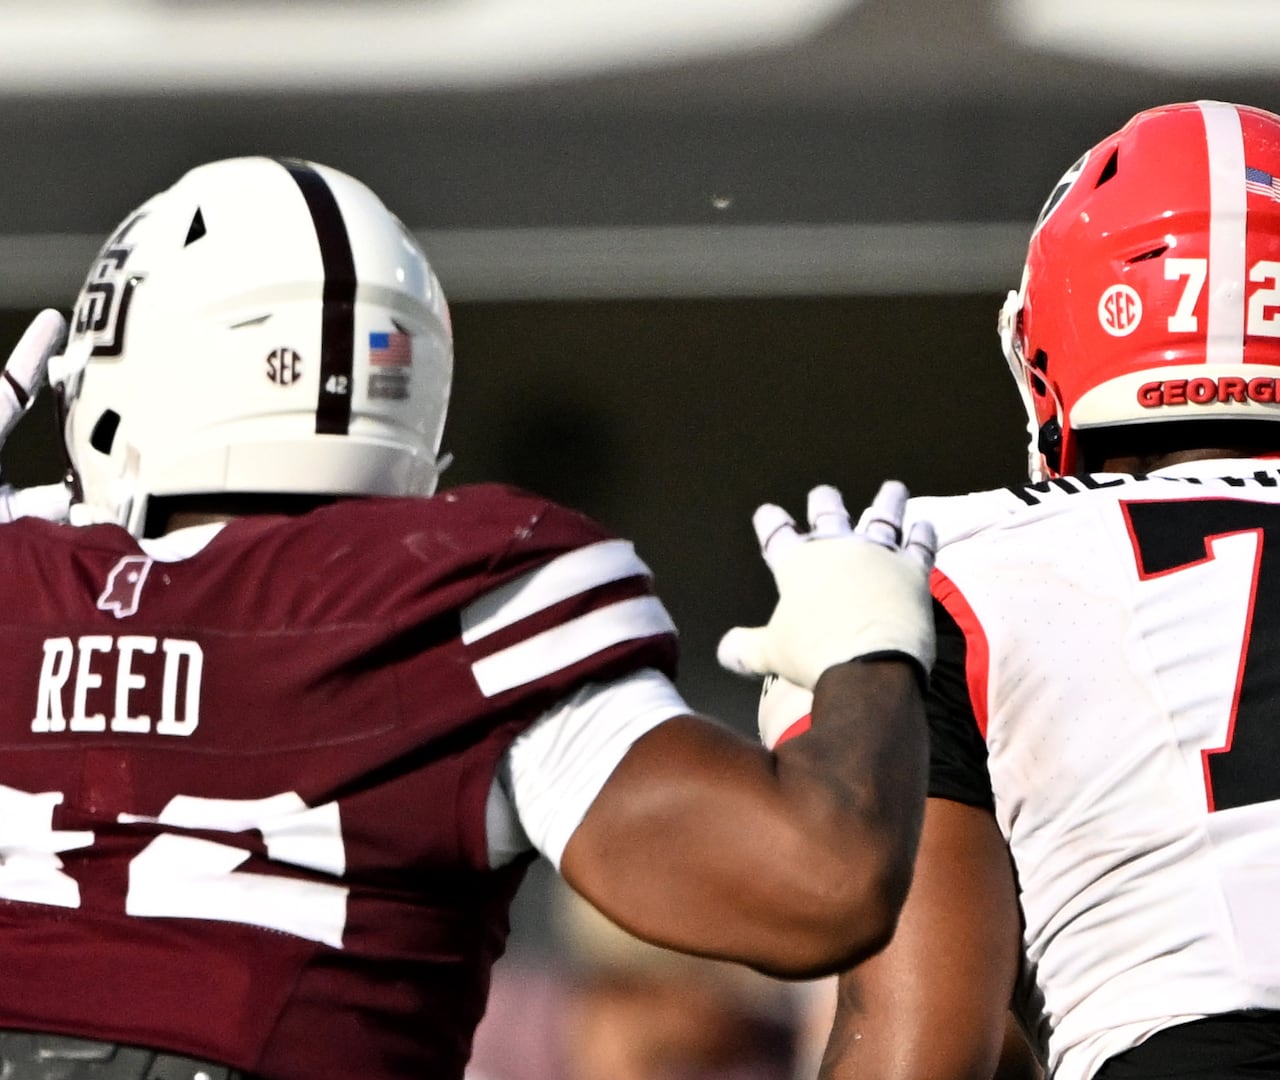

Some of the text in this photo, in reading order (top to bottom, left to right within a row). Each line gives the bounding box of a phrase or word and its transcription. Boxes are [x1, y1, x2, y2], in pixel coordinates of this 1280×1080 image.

[1104, 291, 1137, 330] SEC
[1164, 258, 1280, 338] 72
[266, 348, 301, 385] SEC
[325, 375, 348, 395] 42
[31, 635, 204, 737] REED
